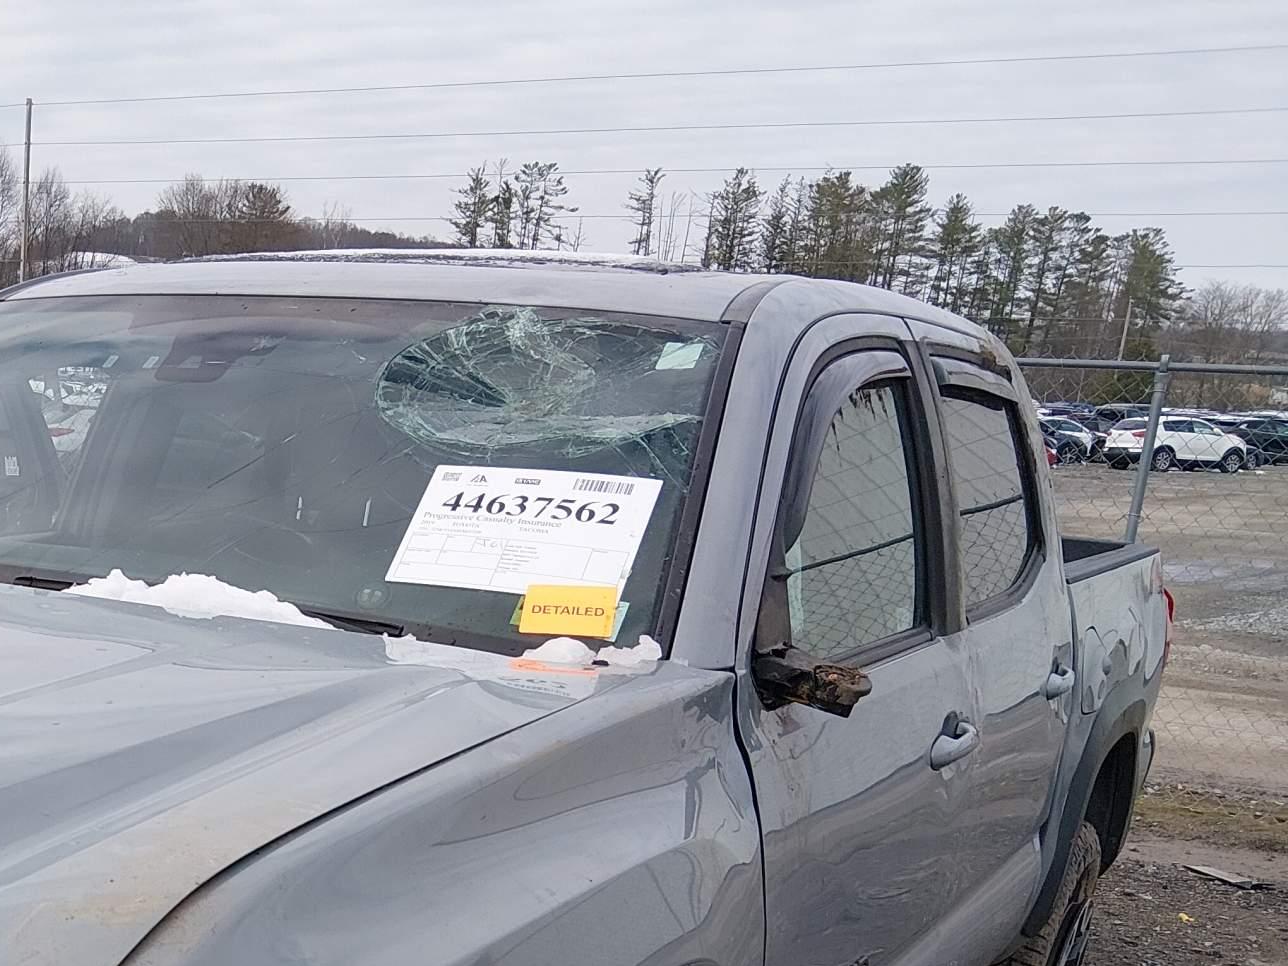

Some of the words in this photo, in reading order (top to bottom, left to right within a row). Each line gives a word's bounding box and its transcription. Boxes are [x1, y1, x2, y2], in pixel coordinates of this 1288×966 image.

[442, 491, 619, 526] 44637562
[476, 514, 514, 524] Casualty
[517, 517, 562, 528] Insurance
[531, 604, 605, 617] DETAILED
